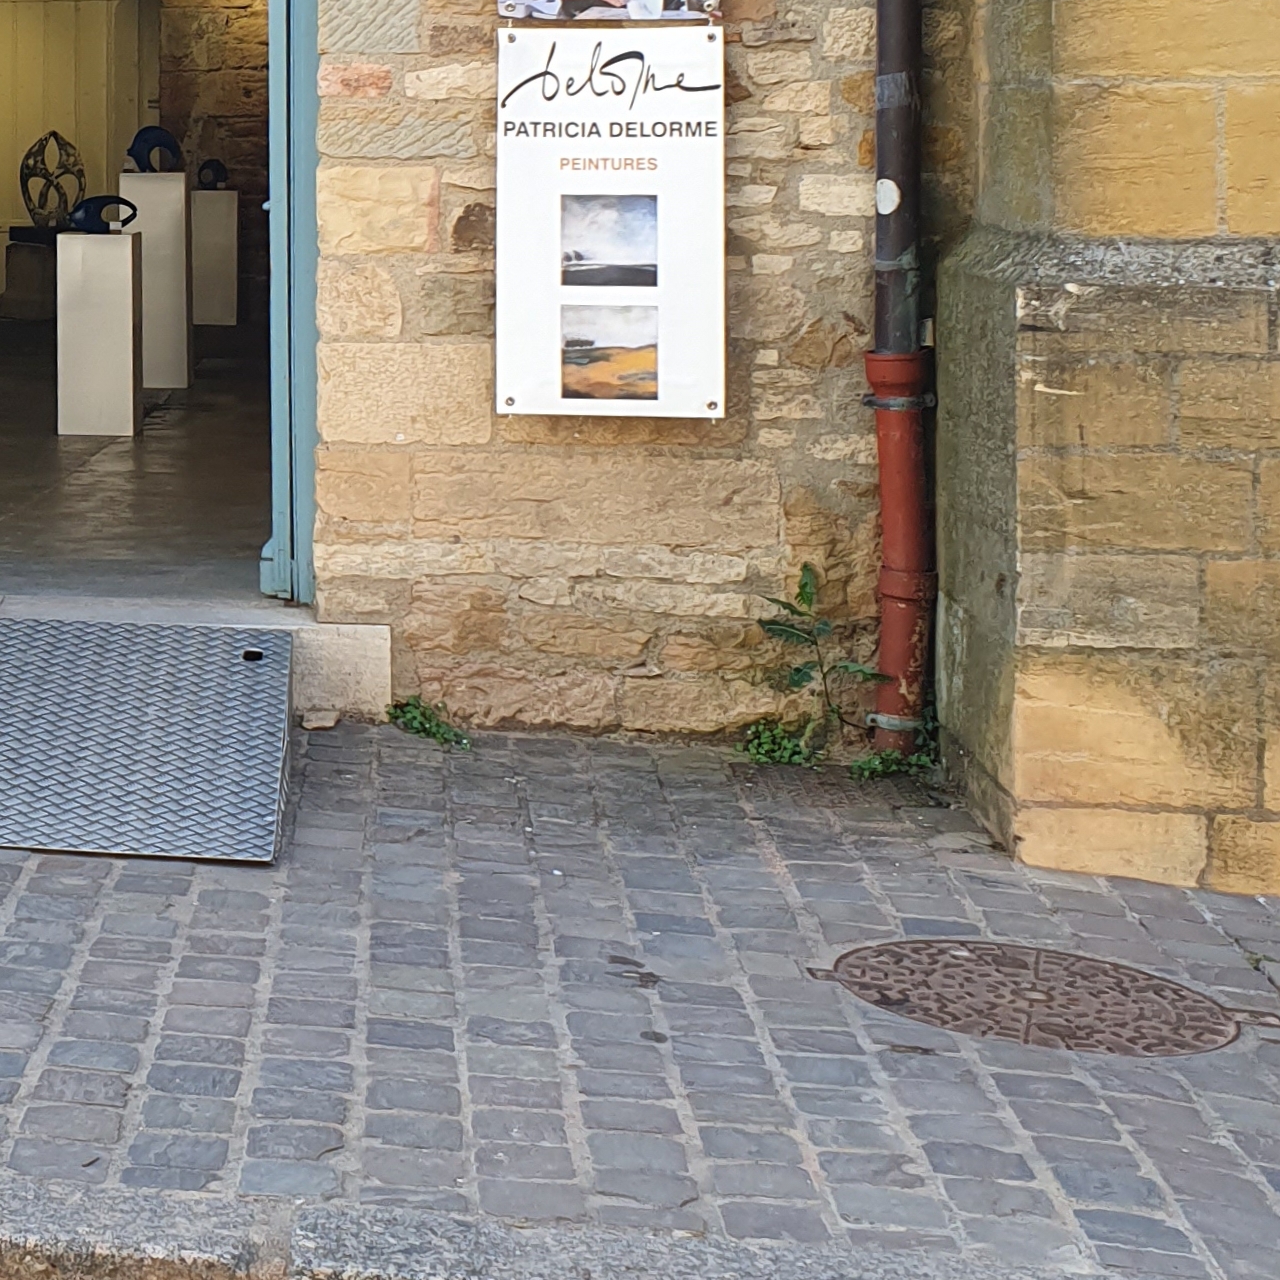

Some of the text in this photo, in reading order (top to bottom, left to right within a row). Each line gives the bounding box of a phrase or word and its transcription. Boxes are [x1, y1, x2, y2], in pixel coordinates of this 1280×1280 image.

[503, 120, 718, 138] PATRICIA DELORME
[559, 157, 659, 171] PEINTURES
